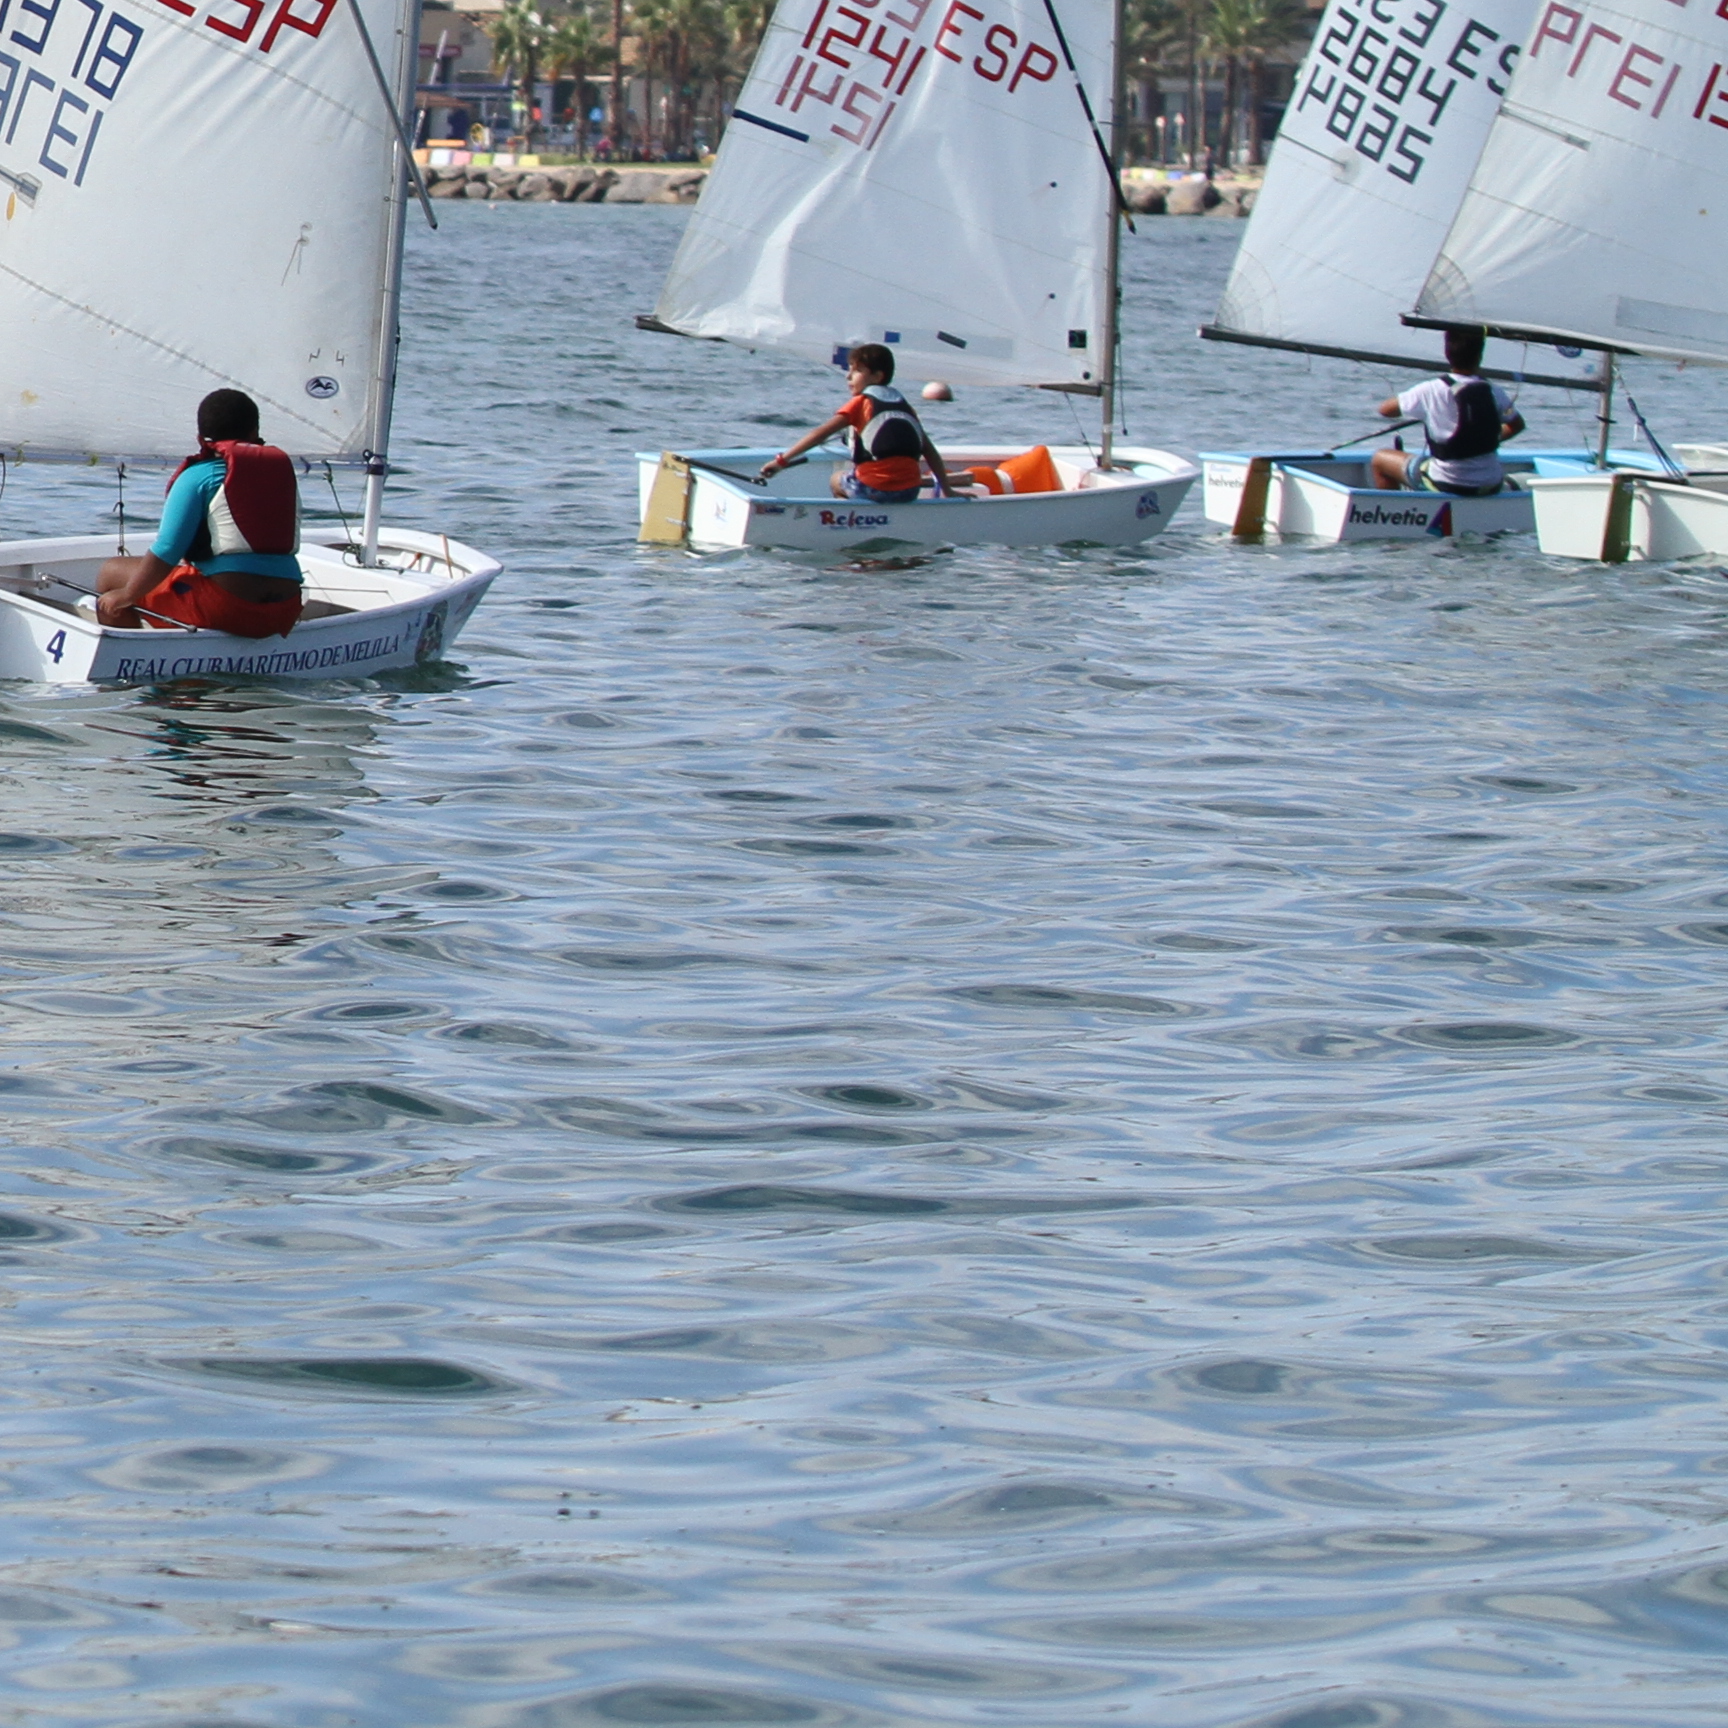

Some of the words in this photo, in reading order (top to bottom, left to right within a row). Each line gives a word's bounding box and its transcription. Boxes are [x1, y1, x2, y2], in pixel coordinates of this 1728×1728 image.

[1319, 6, 1458, 128] 2684
[818, 509, 889, 529] Releva
[1349, 504, 1429, 527] helvetia
[46, 628, 68, 665] 4
[319, 643, 341, 668] DE
[343, 633, 400, 663] MELILLA
